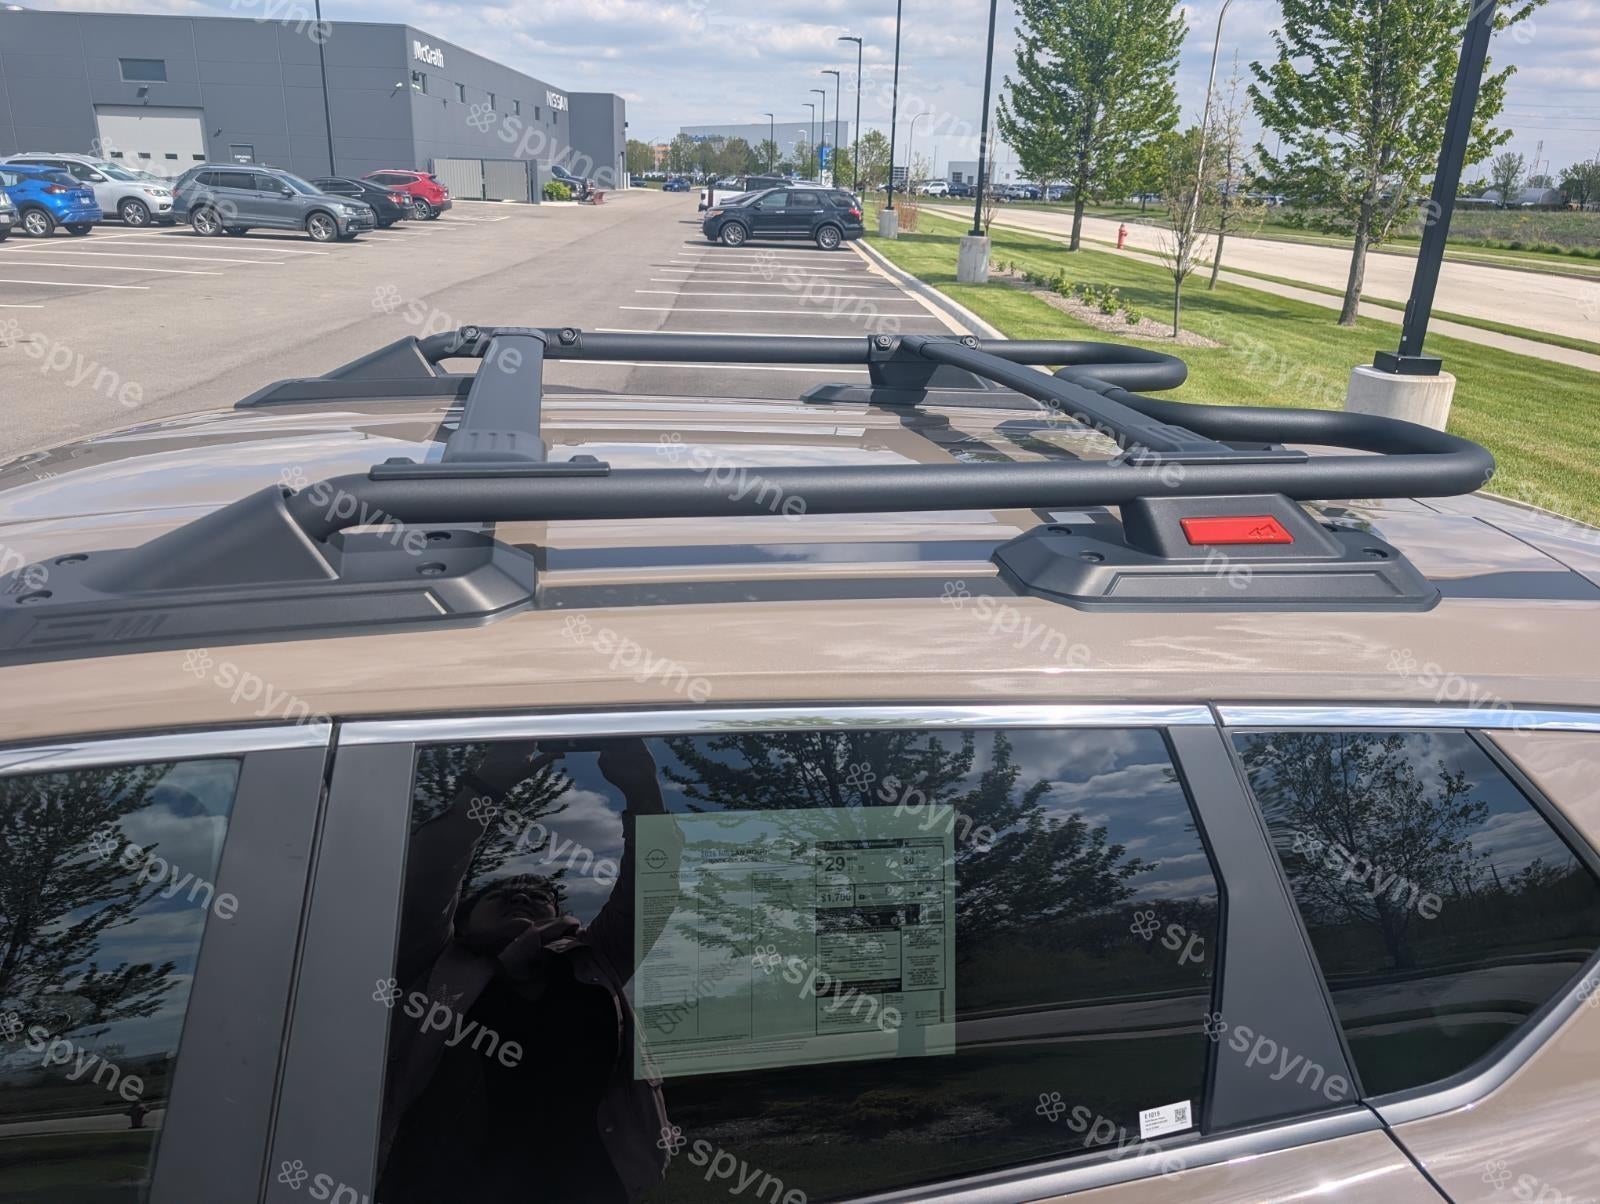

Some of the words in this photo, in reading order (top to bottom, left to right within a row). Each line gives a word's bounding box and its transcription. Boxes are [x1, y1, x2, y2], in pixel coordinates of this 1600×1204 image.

[412, 40, 445, 69] McGrath
[546, 89, 569, 112] NISSAN
[824, 856, 846, 872] 29
